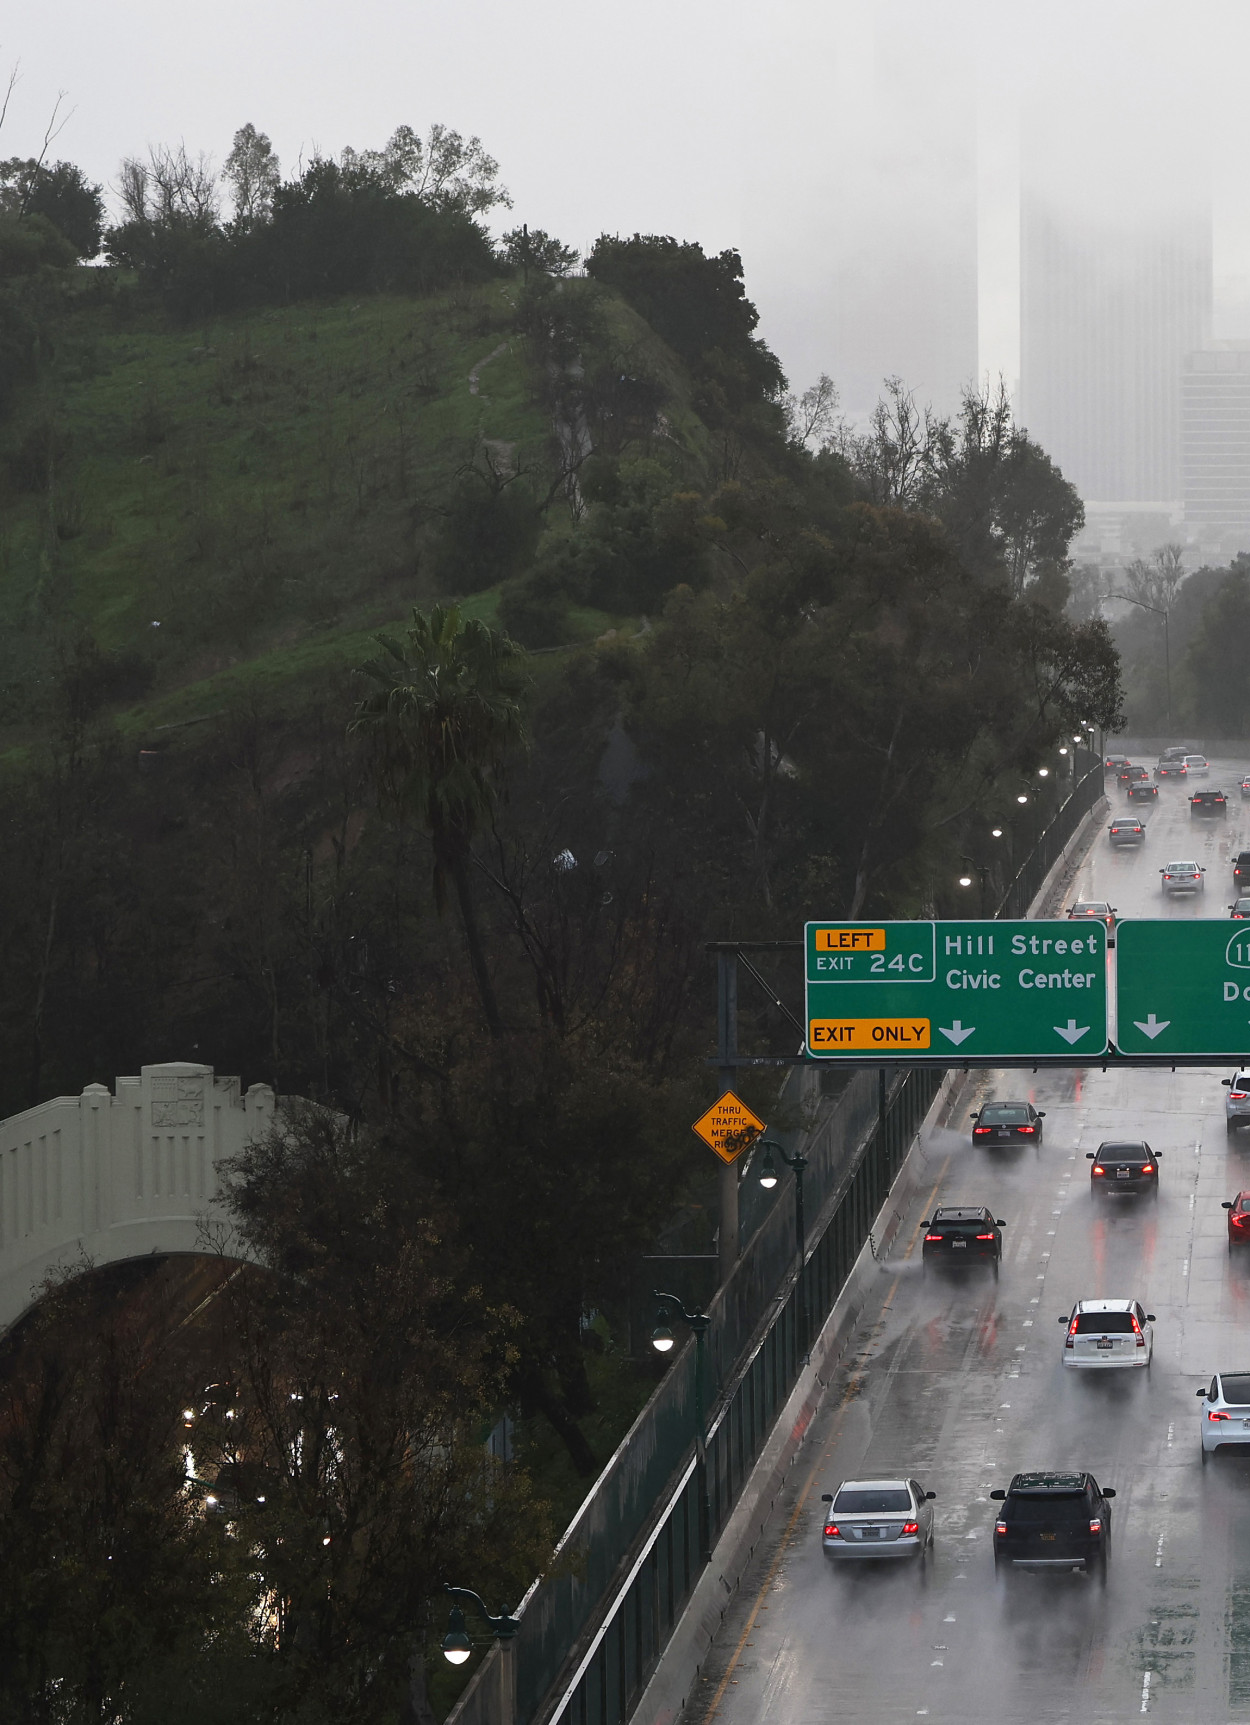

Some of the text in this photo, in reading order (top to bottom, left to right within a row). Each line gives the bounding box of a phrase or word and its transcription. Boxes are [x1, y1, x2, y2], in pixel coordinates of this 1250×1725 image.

[827, 932, 874, 948] LEFT
[945, 934, 1098, 955] Hill Street
[816, 953, 924, 973] EXIT 24C
[945, 968, 1096, 989] Civic Center
[813, 1026, 926, 1042] EXIT ONLY
[717, 1106, 741, 1114] THRU
[711, 1117, 747, 1125] TRAFFIC
